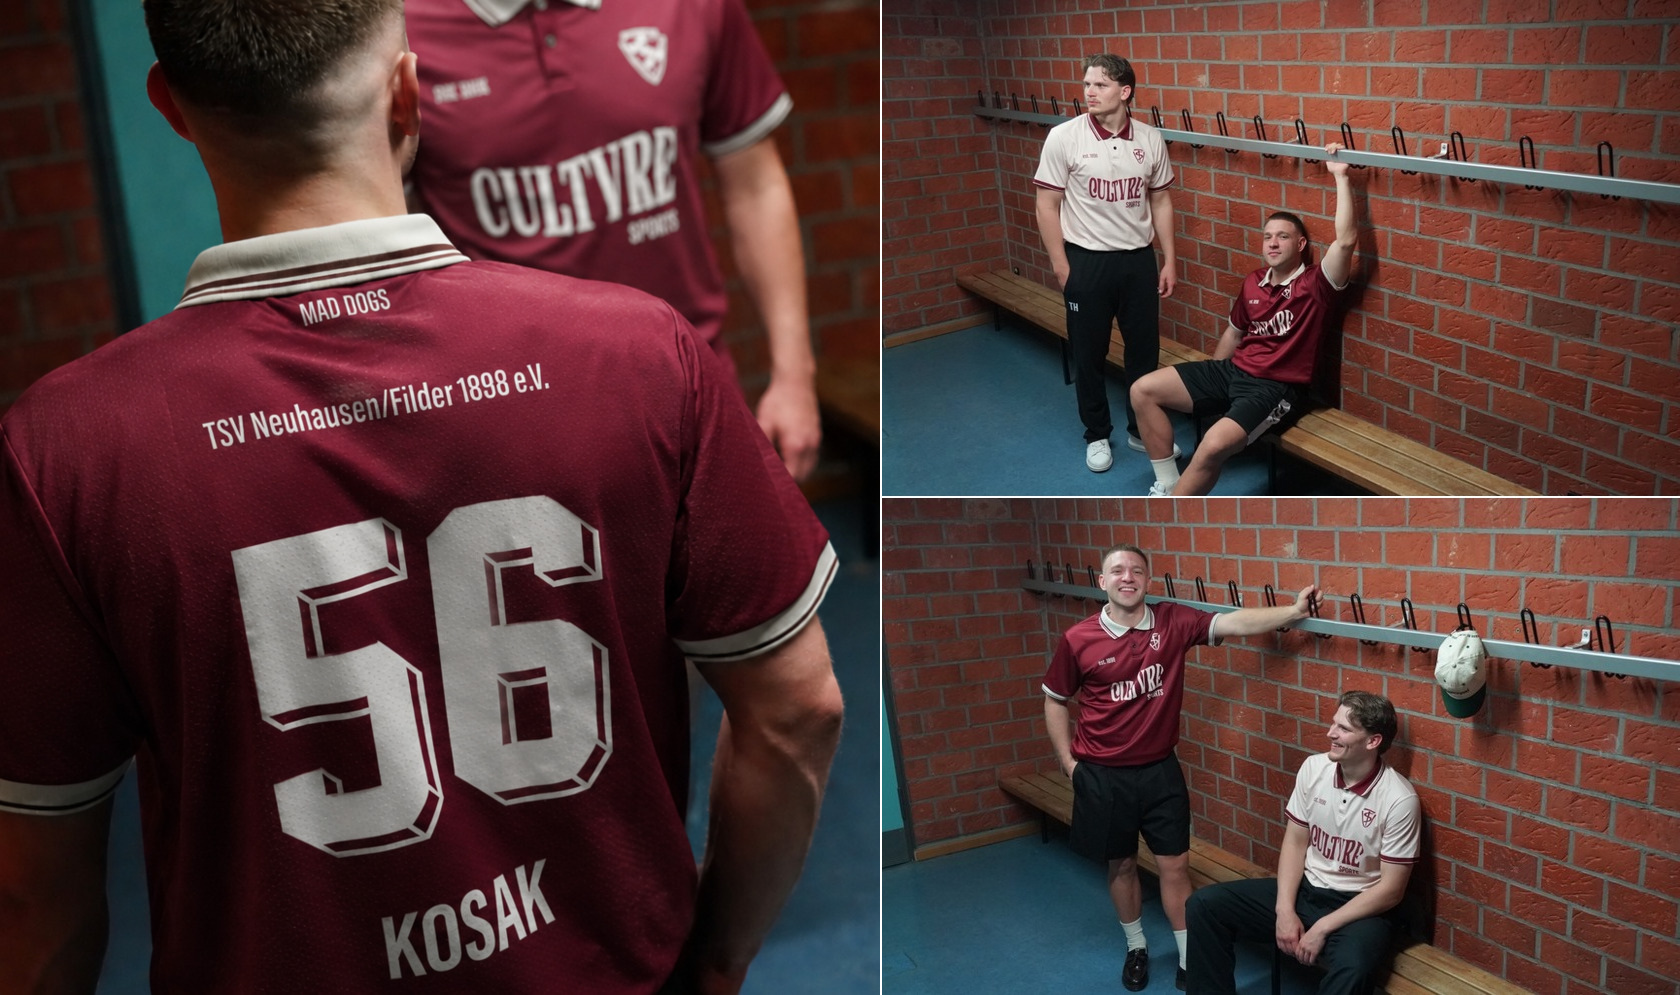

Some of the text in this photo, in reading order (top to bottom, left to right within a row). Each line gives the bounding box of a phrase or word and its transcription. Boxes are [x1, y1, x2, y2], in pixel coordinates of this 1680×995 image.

[470, 126, 678, 238] CULTVRE
[1089, 177, 1144, 203] CULTVRE
[627, 207, 680, 246] SPORTS
[299, 288, 391, 326] MAD DOGS
[1068, 301, 1079, 312] TH
[202, 362, 551, 450] TSV Neuhausen/Filder 1898 e.V.
[231, 495, 613, 858] 56
[381, 858, 556, 980] KOSAK
